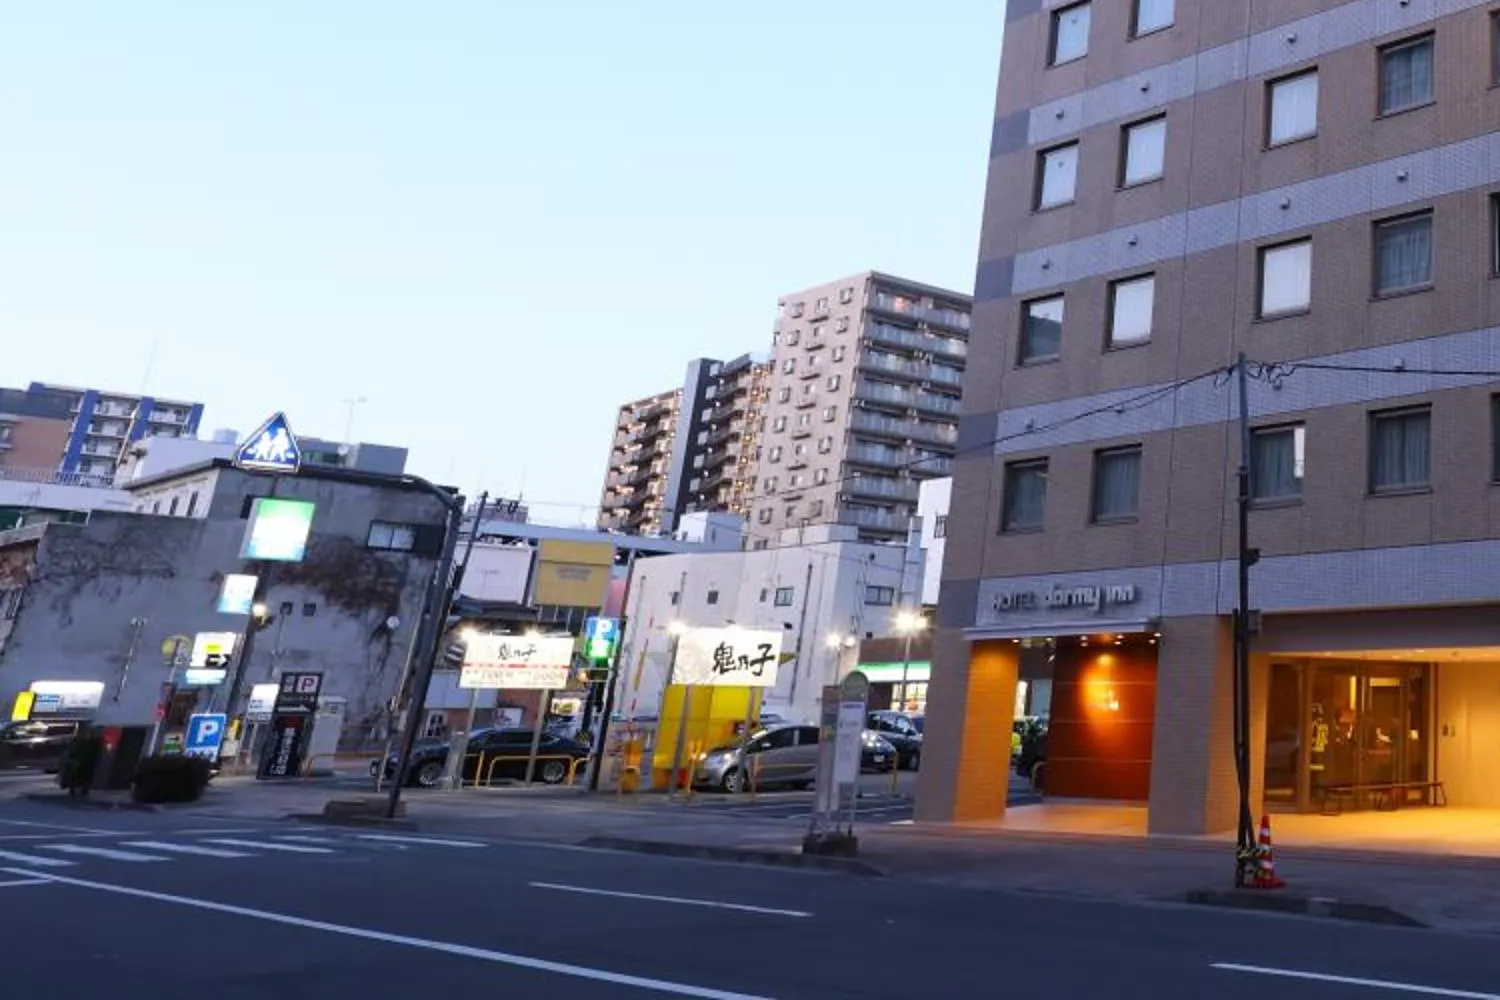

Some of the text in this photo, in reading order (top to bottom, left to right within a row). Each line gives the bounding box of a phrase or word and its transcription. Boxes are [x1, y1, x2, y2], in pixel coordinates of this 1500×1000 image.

[1044, 584, 1100, 612] dormy
[1105, 582, 1135, 603] inn
[596, 619, 612, 639] P
[196, 720, 219, 744] P
